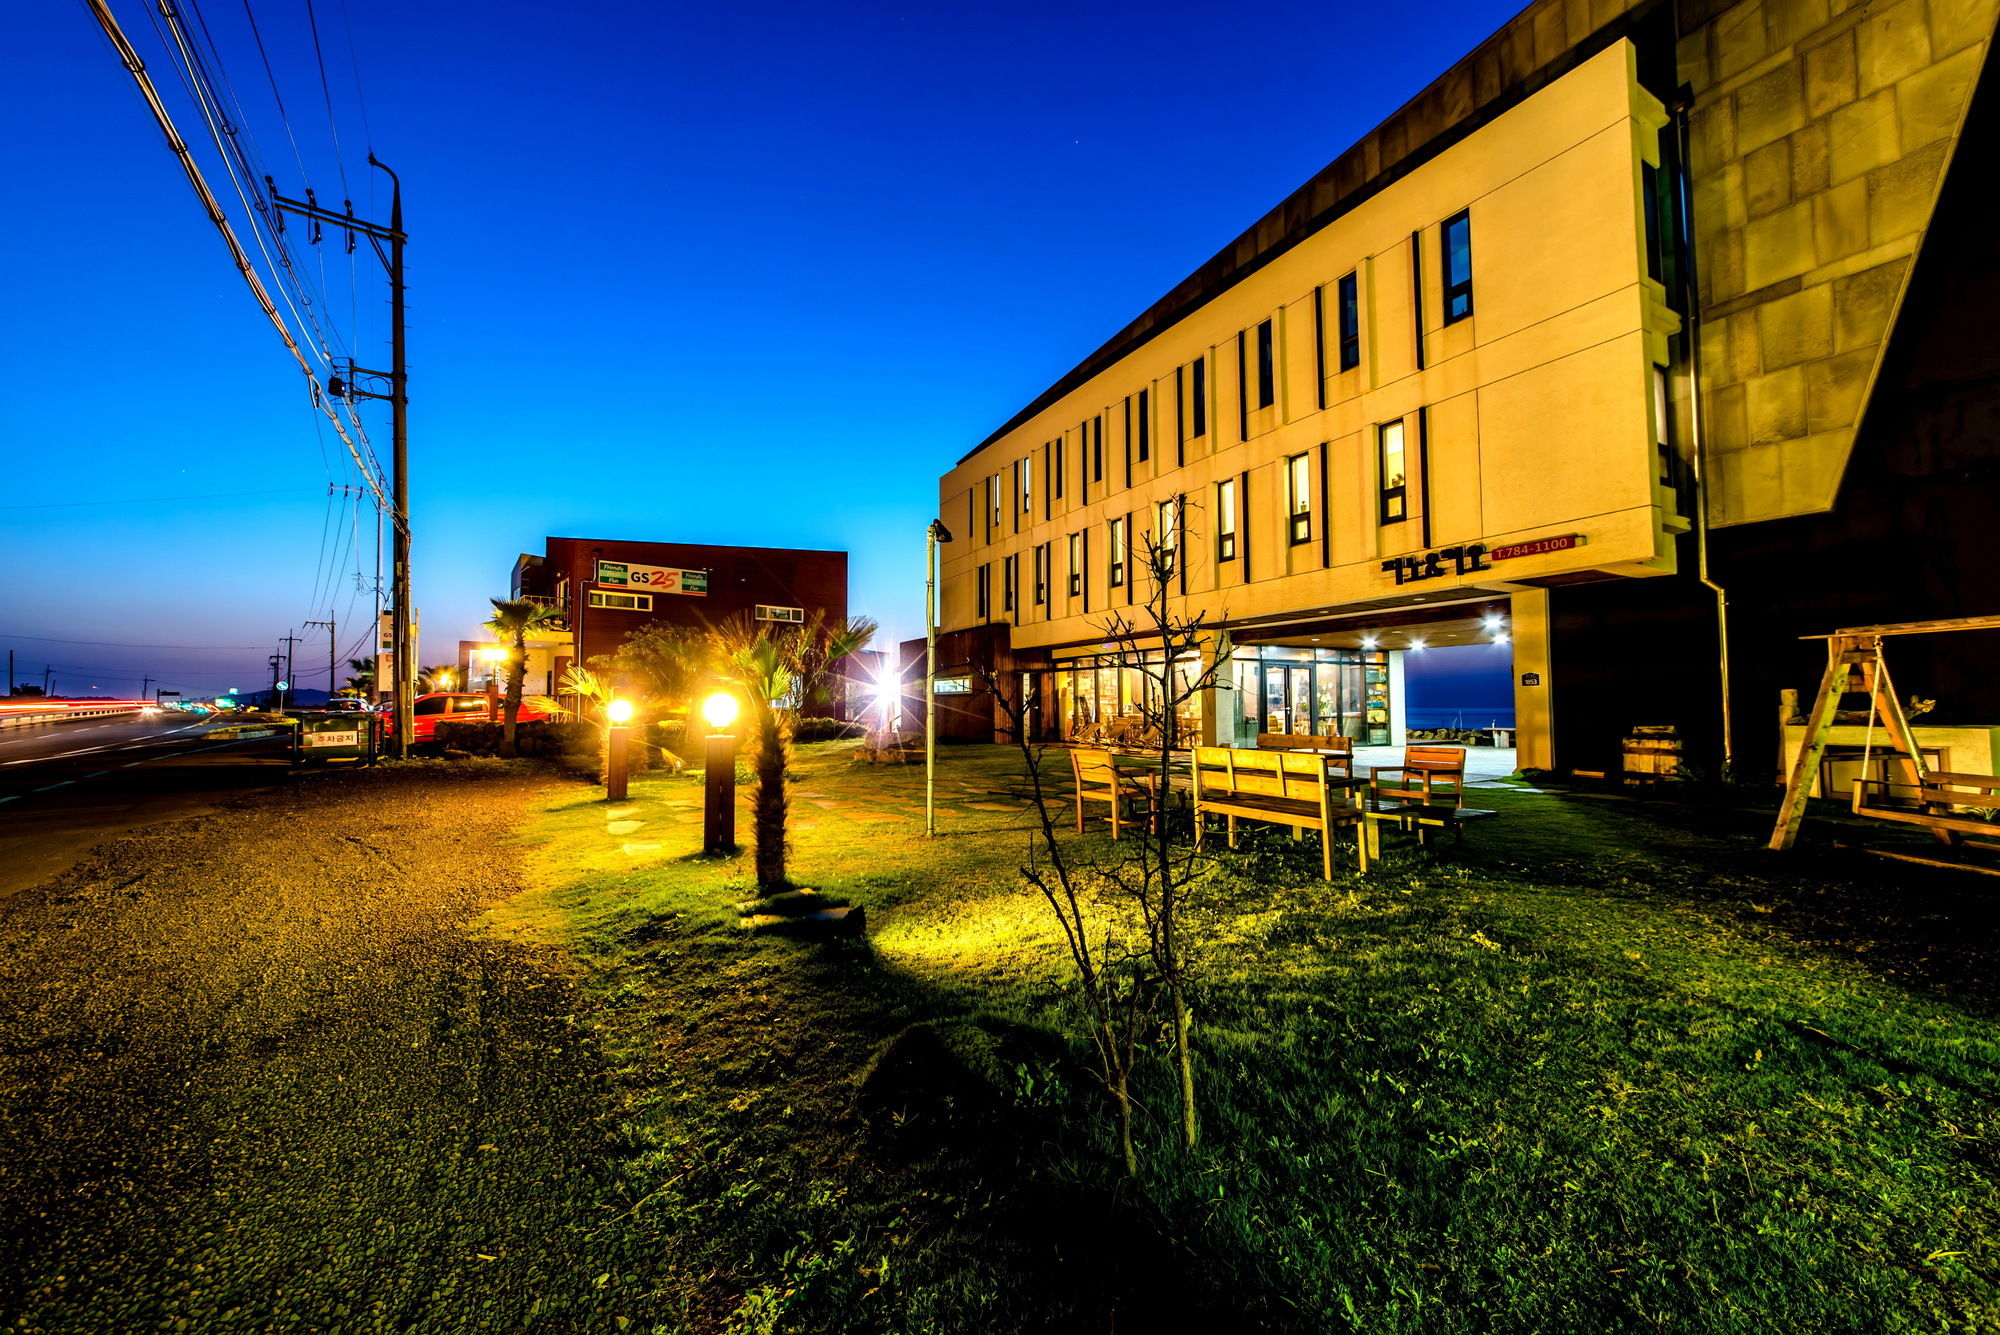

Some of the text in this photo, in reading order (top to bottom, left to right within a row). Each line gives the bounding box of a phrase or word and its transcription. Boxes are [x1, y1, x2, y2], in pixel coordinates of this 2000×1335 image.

[1496, 538, 1567, 559] T.784-1100
[631, 571, 679, 589] GS25
[317, 734, 354, 743] 주차금지
